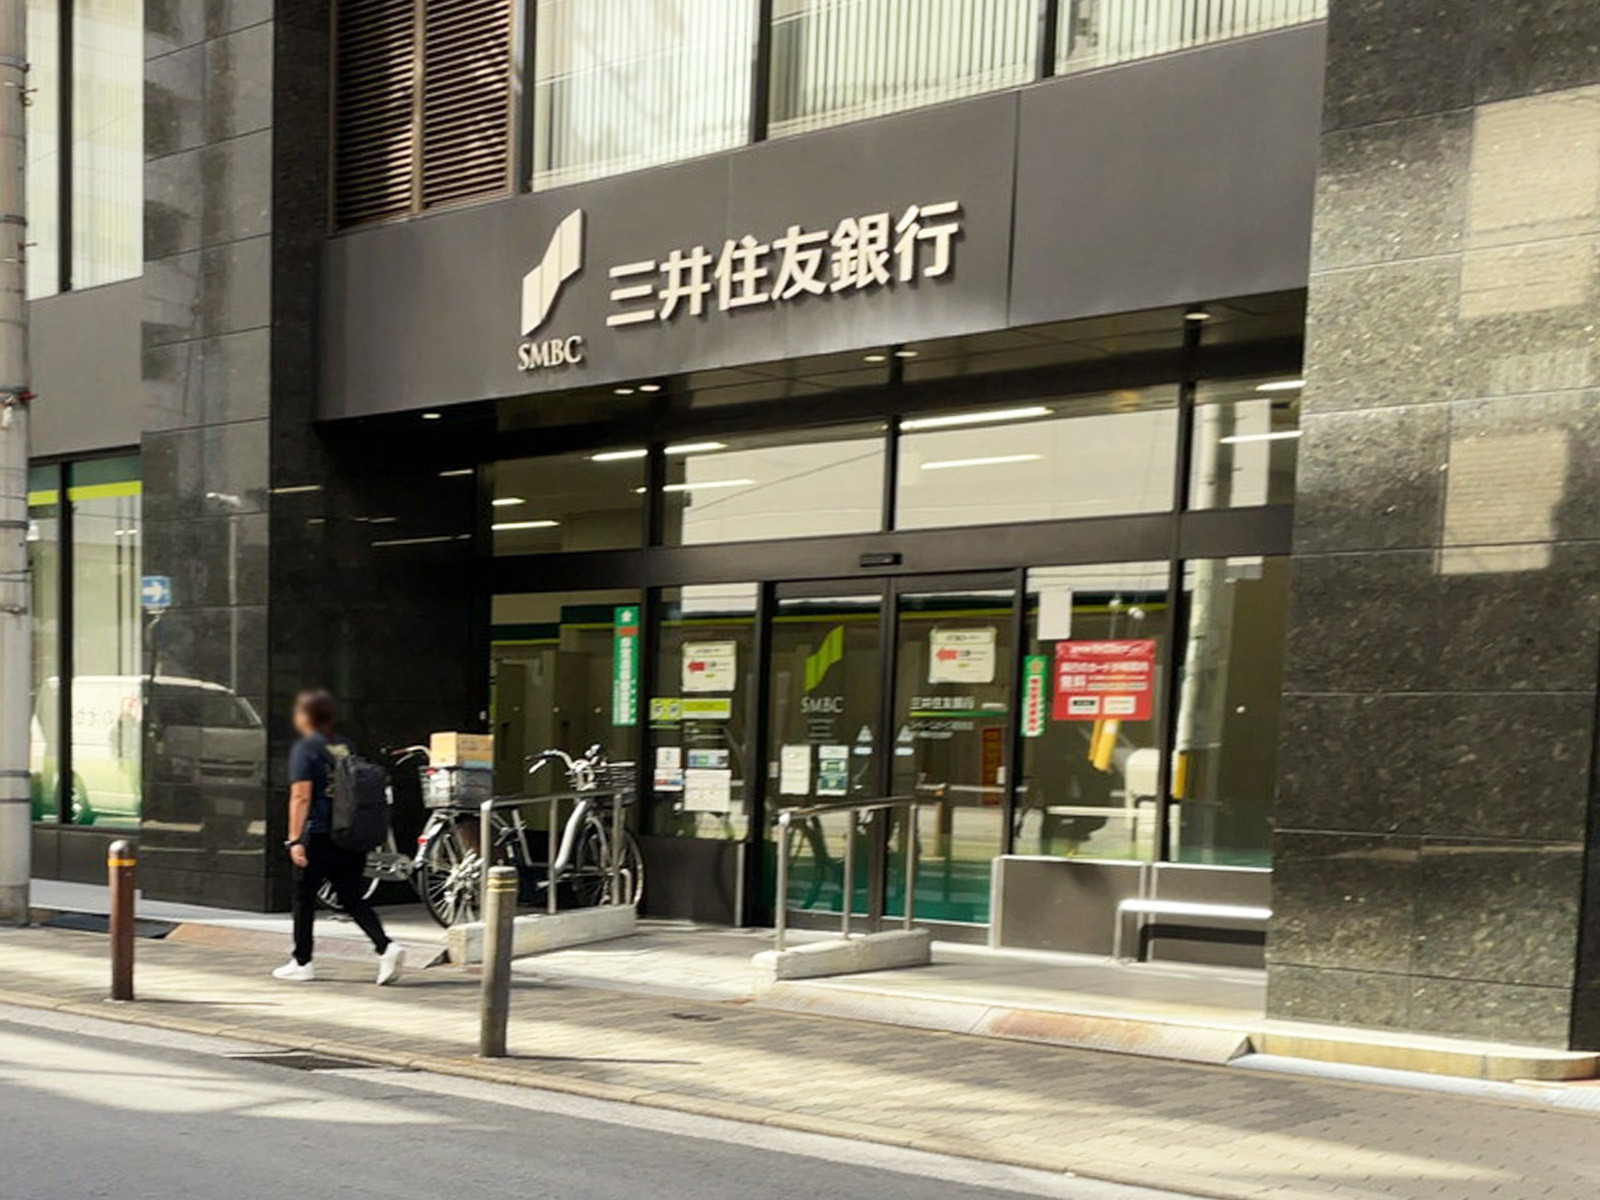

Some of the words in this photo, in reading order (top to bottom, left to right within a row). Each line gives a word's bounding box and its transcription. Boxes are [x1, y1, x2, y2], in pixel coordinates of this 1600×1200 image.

[606, 200, 960, 327] 三井住友銀行
[517, 335, 583, 371] SMBC
[800, 695, 844, 714] SMBC
